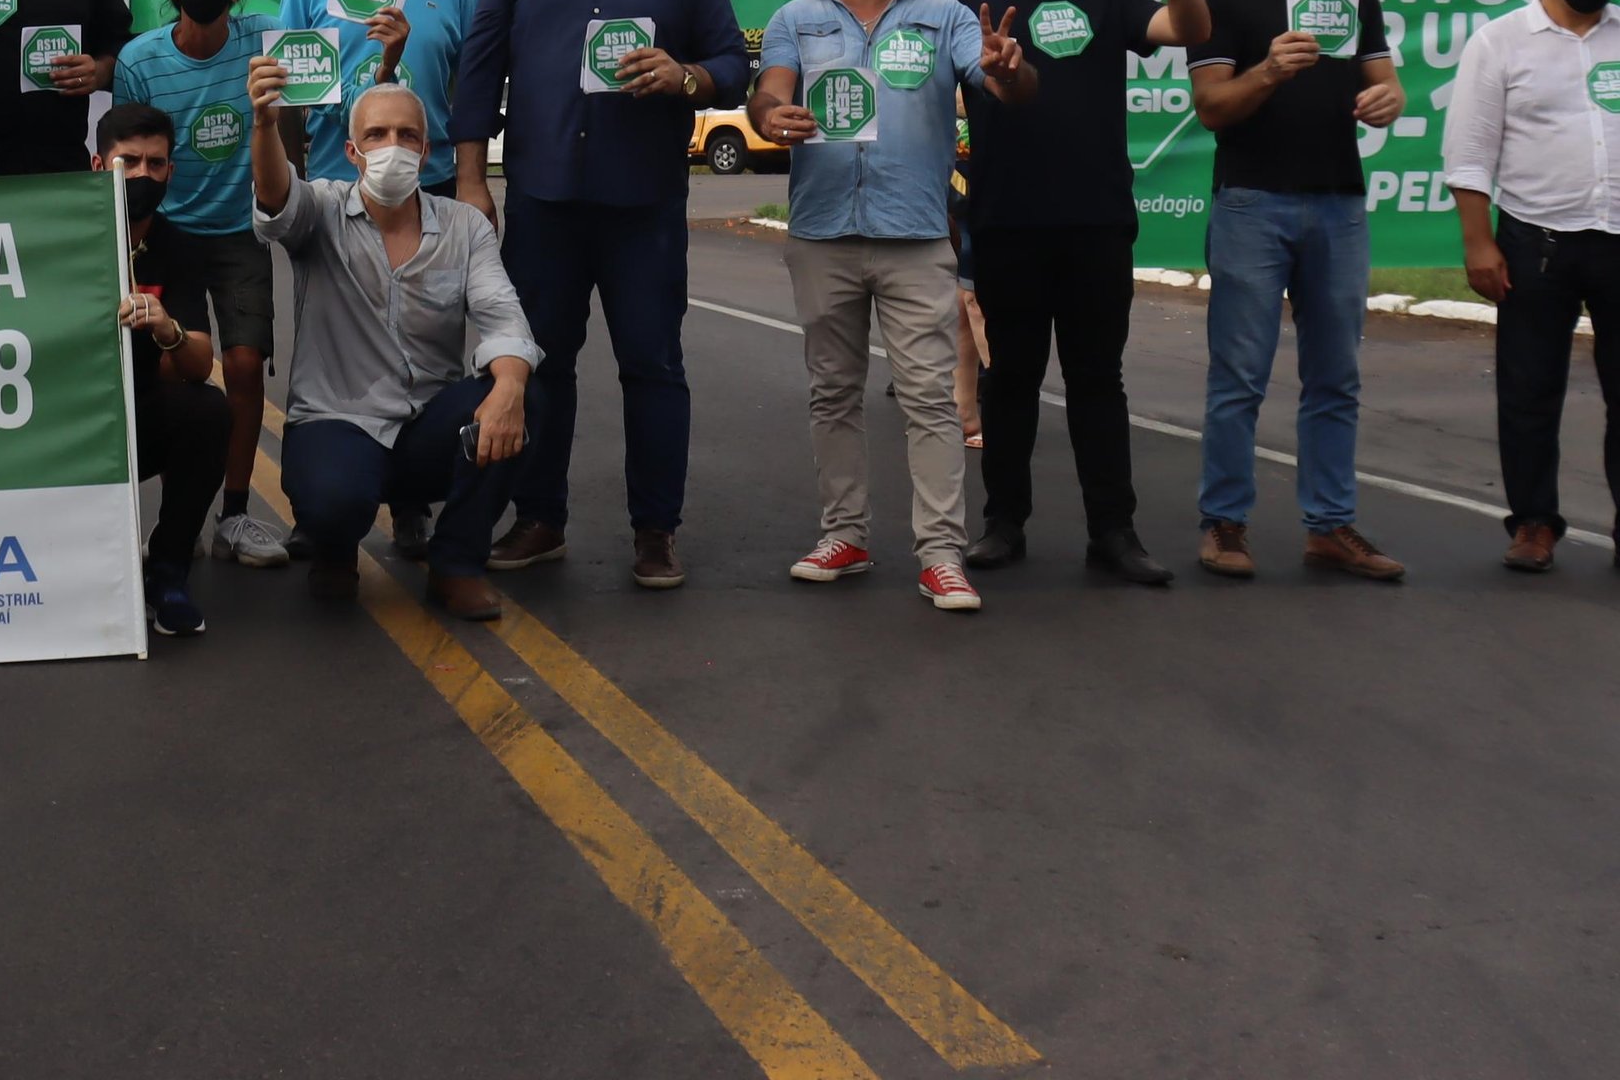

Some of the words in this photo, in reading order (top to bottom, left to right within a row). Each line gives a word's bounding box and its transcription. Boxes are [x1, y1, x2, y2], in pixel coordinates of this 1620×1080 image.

[1308, 0, 1342, 13] RS118
[1041, 8, 1075, 21] RS118
[1299, 12, 1349, 27] SEM
[1035, 18, 1086, 36] SEM
[36, 36, 68, 51] RS118
[603, 30, 637, 46] RS118
[1039, 30, 1088, 44] PEDÁGIO
[283, 42, 322, 59] RS118
[889, 39, 923, 51] RS118
[880, 49, 930, 65] SEM
[880, 61, 929, 74] PEDÁGIO
[285, 71, 332, 85] EDÁGIO
[824, 77, 837, 129] PEDÁGIO
[834, 75, 851, 129] SEM
[850, 84, 864, 120] RS118
[195, 122, 240, 142] SEM
[196, 135, 240, 149] PEDÁGIO
